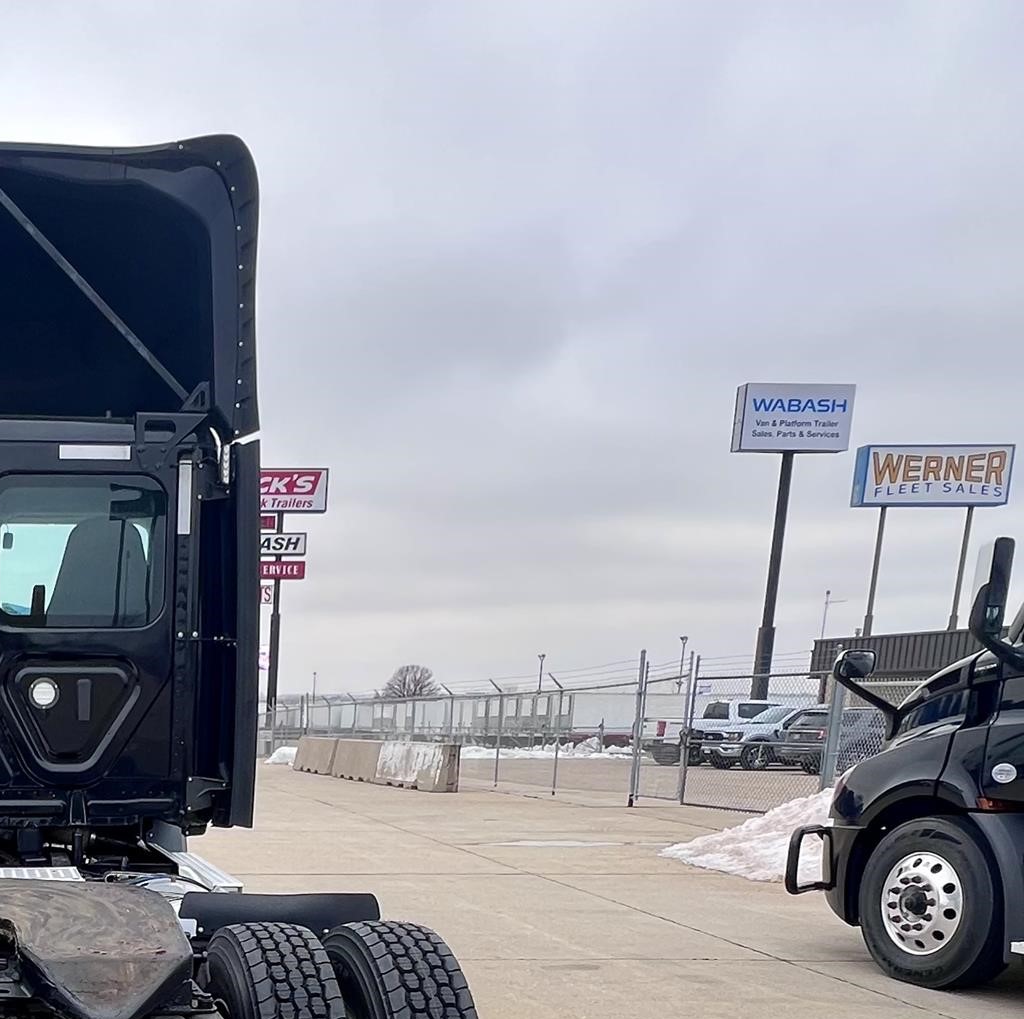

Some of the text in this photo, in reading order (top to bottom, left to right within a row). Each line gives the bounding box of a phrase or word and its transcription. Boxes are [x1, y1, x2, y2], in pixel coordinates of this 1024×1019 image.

[753, 398, 847, 412] WABASH
[756, 419, 839, 428] Van & Platform Trailer
[776, 430, 797, 438] Parts
[798, 430, 805, 438] &
[806, 430, 840, 438] Services
[872, 450, 1007, 486] WERNER
[874, 482, 1003, 498] FLEET SALES
[271, 498, 314, 508] Trailers
